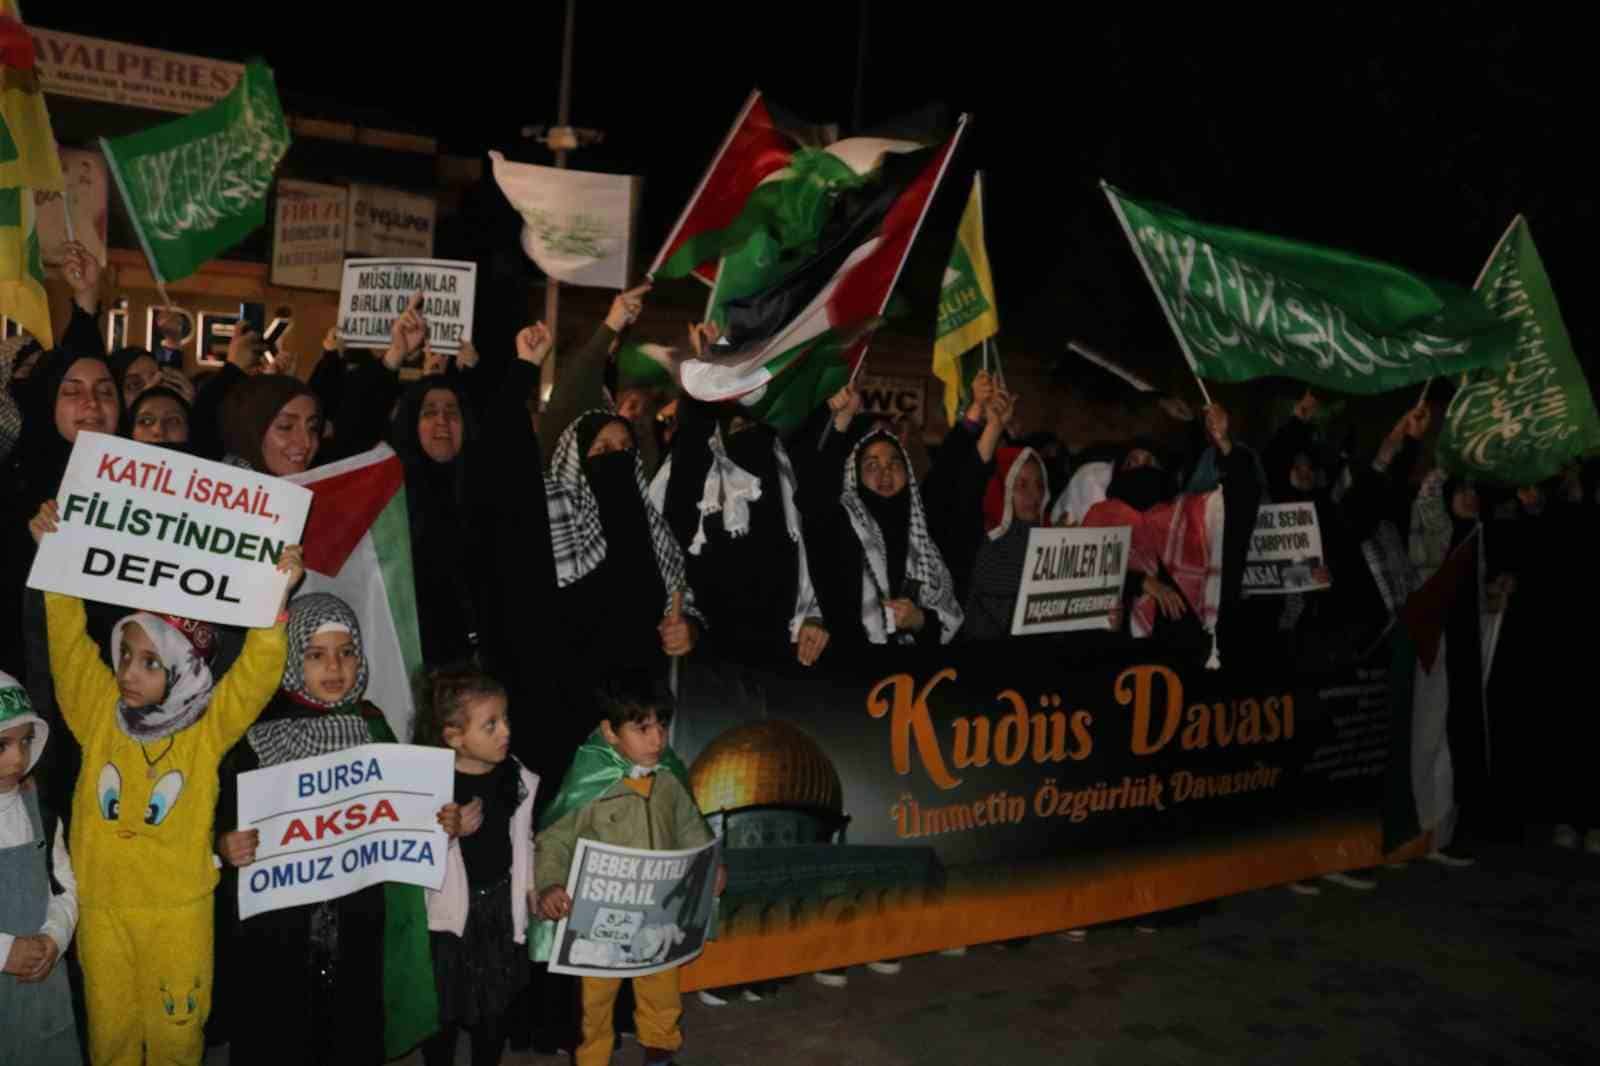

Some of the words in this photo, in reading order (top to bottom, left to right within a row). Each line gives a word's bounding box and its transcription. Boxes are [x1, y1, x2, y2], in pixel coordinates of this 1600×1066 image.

[358, 267, 457, 292] MÜSLÜMANLAR
[351, 293, 393, 313] BİRLİK
[397, 295, 461, 317] OADAN
[426, 320, 465, 342] İTMEZ
[97, 453, 176, 496] KATİL
[184, 468, 280, 523] İSRAİL,
[62, 492, 285, 565] FİLİSTİNDEN
[82, 546, 241, 603] DEFOL
[1032, 537, 1098, 581] ZALİMLER
[1100, 534, 1123, 585] İÇİN
[866, 668, 1094, 790] Kudüs
[1114, 665, 1295, 756] Davası
[298, 758, 383, 798] BURSA
[889, 788, 1025, 839] Ümmetin
[1034, 776, 1165, 823] Özgürlük
[1170, 766, 1281, 802] Davasıdır
[280, 799, 399, 846] AKSA
[250, 856, 333, 893] OMUZ
[341, 839, 435, 873] OMUZA
[587, 851, 640, 880] BEBEK
[581, 876, 656, 905] İSRAİL
